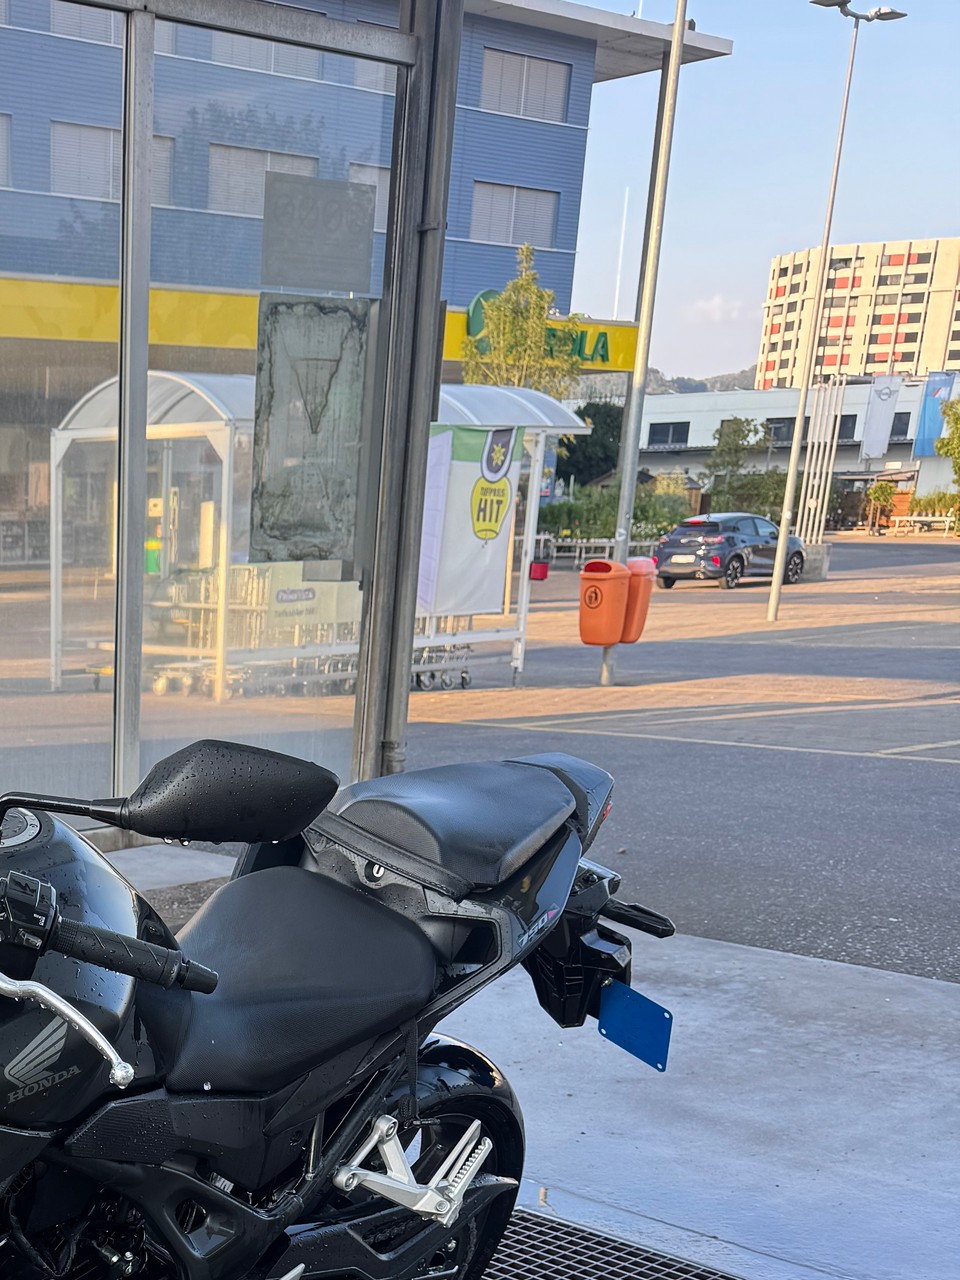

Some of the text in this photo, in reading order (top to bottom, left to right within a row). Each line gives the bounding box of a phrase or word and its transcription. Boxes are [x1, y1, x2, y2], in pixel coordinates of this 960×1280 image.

[476, 497, 504, 523] HIT
[518, 912, 549, 947] 750
[7, 1065, 82, 1104] HONDA
